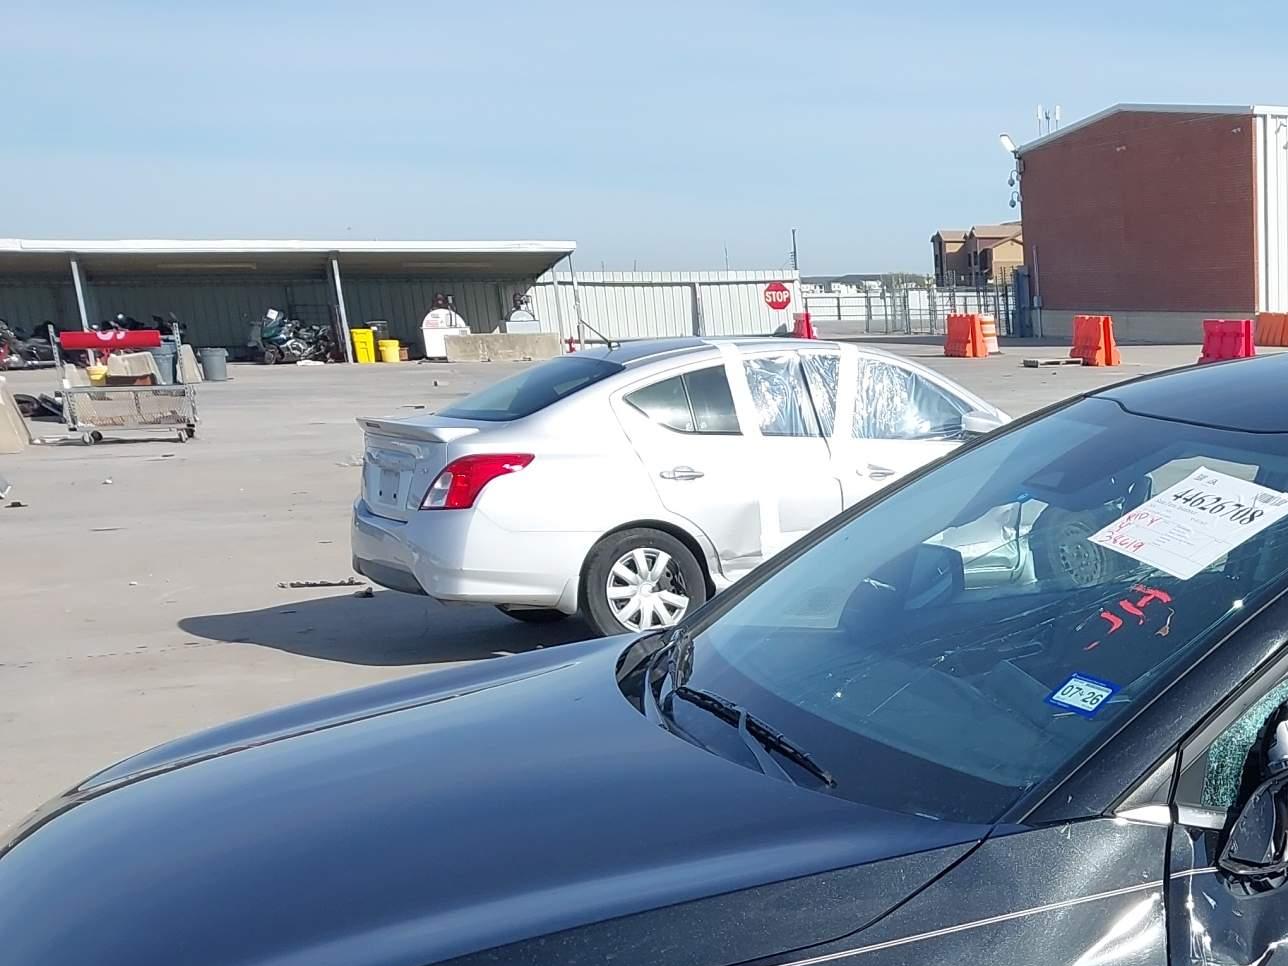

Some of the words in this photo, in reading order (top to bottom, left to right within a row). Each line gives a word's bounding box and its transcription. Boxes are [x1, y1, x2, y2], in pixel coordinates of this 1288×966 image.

[766, 291, 789, 302] STOP
[1173, 488, 1264, 525] 44626708
[1060, 685, 1082, 698] 07
[1082, 691, 1104, 706] 26
